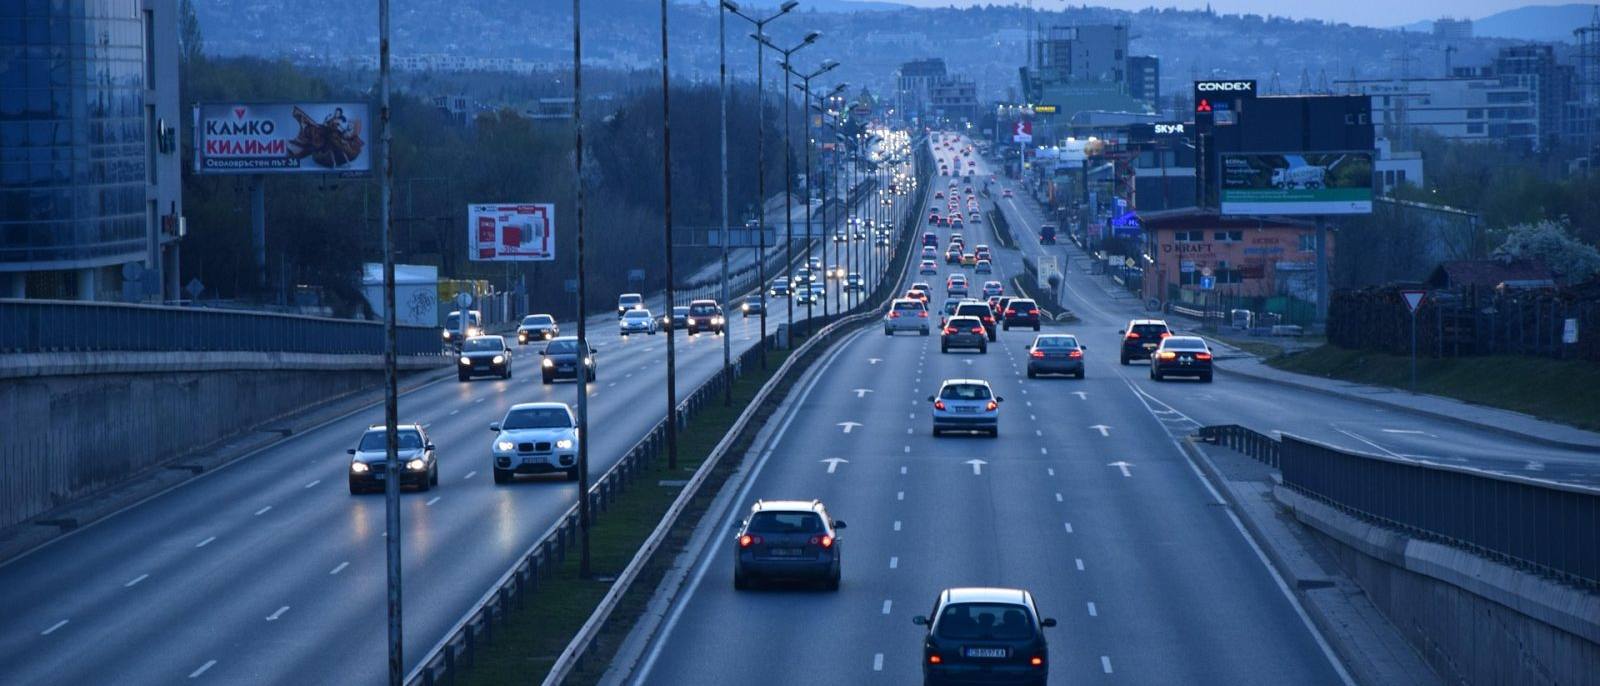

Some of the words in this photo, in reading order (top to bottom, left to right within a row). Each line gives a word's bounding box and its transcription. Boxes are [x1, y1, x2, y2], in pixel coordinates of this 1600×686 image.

[1197, 82, 1251, 91] CONDEX
[206, 120, 275, 135] КАМКО
[206, 140, 285, 154] КИЛИМИ
[206, 158, 270, 169] Околовръстен
[271, 159, 286, 168] път
